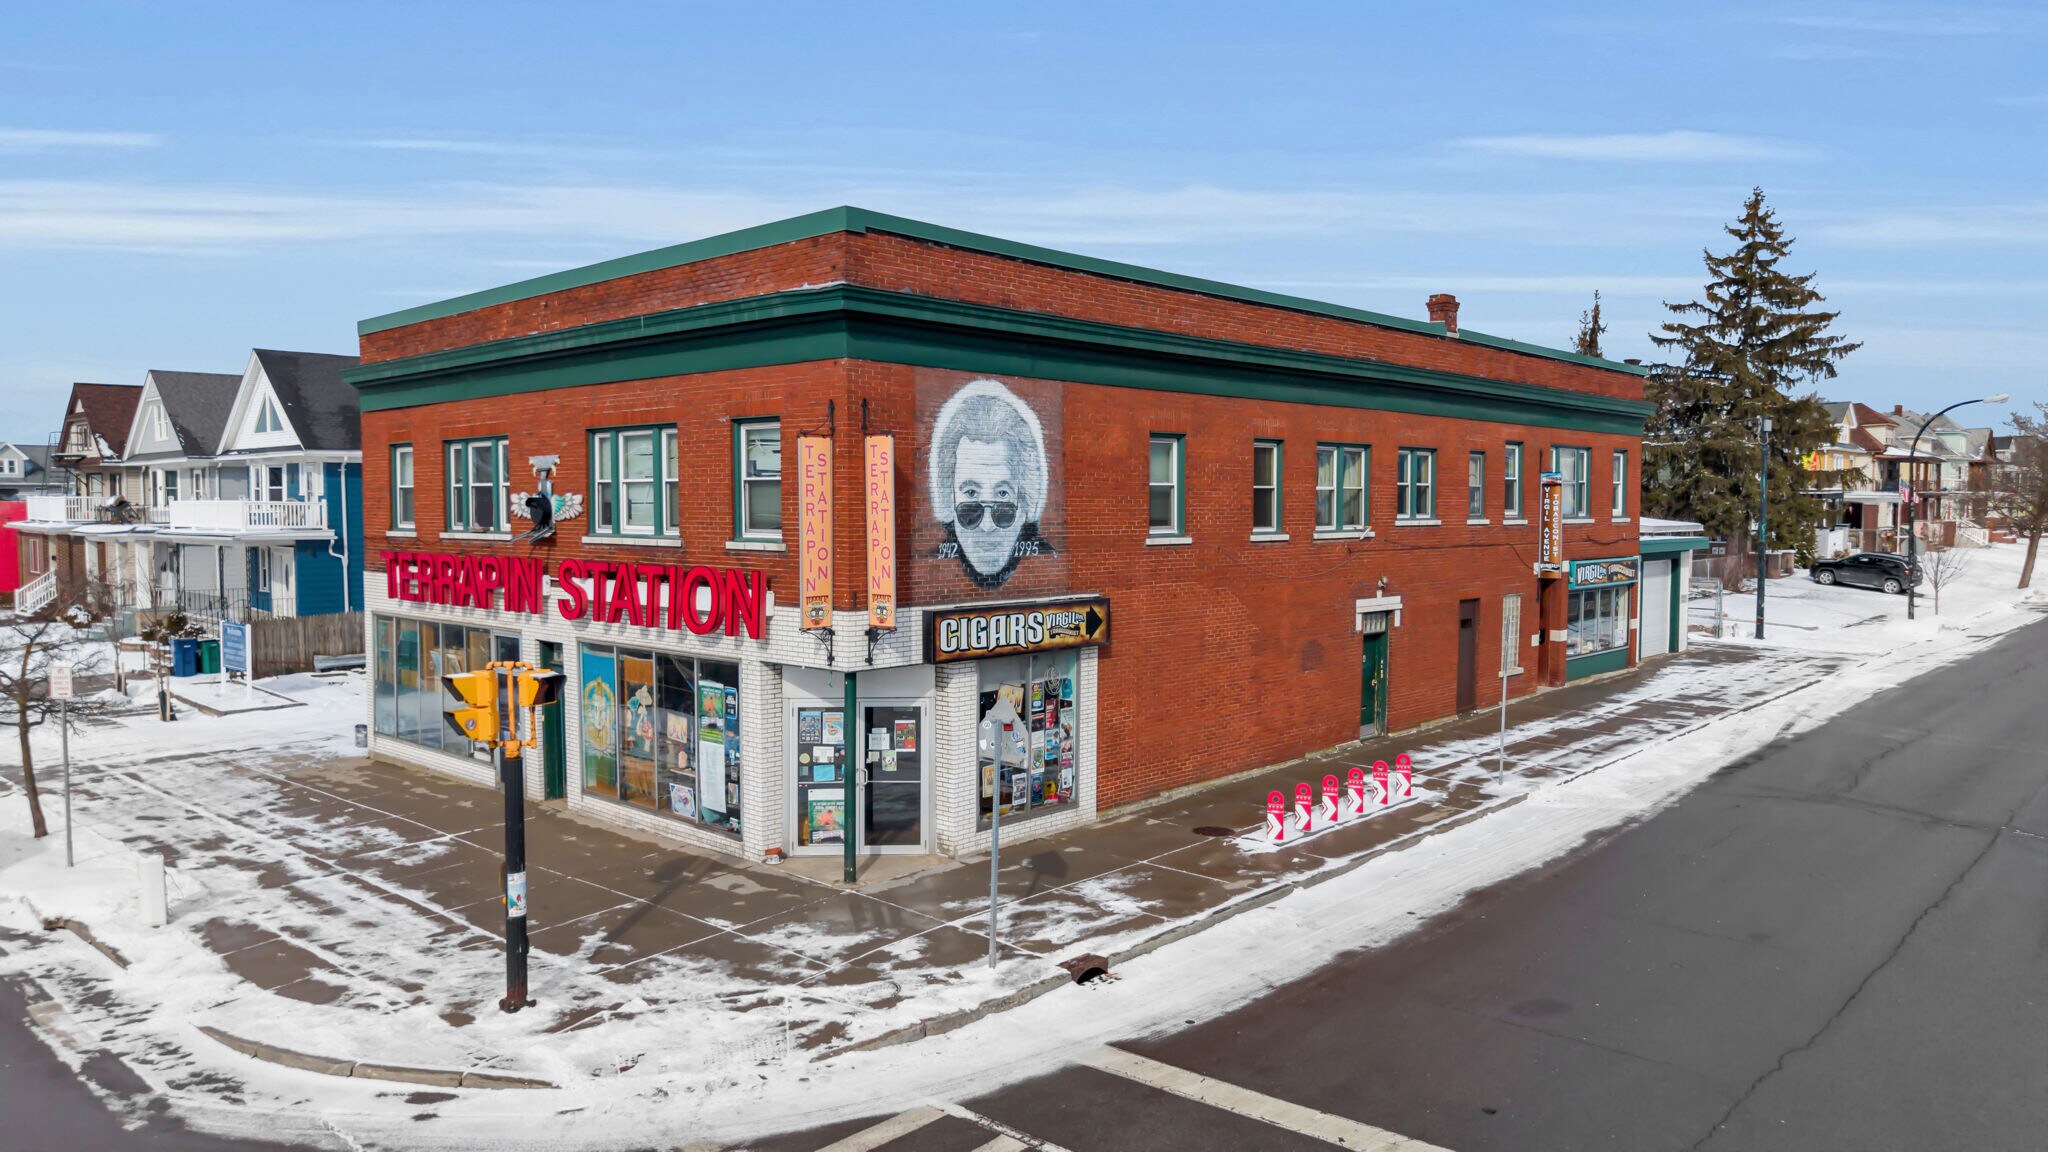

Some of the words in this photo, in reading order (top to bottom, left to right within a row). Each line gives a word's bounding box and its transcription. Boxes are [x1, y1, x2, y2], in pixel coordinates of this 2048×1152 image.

[804, 444, 817, 592] TERRAPIN
[816, 452, 829, 580] STATION
[869, 444, 881, 590] TERRAPIN
[880, 451, 891, 579] STATION
[937, 542, 958, 559] 1942
[1013, 541, 1040, 557] 1995
[1577, 564, 1603, 584] VIRGIL
[380, 551, 544, 615] TERRAPIN
[558, 558, 768, 640] STATION
[1046, 611, 1078, 630] VIRGIL
[940, 611, 1044, 652] CIGARS
